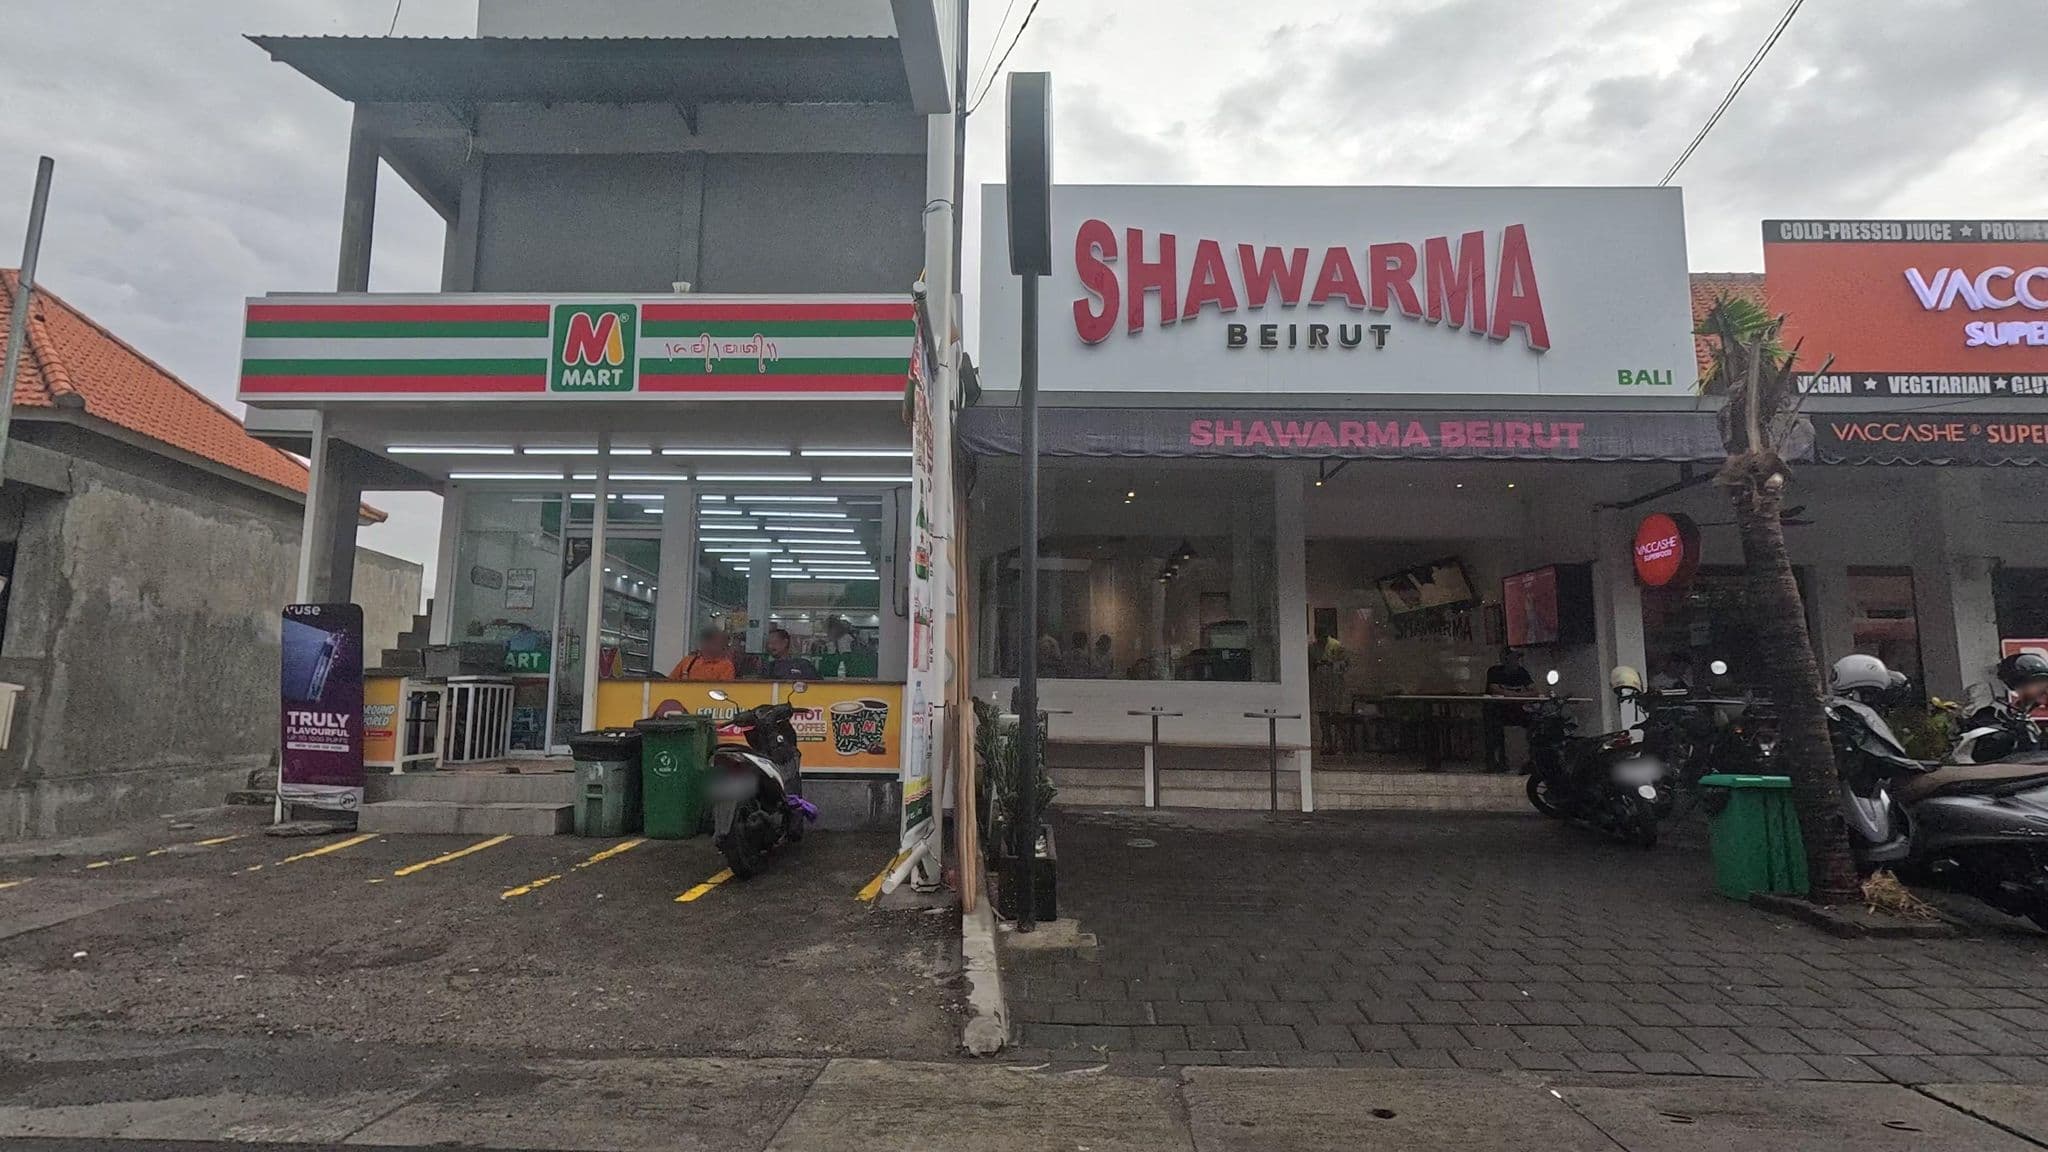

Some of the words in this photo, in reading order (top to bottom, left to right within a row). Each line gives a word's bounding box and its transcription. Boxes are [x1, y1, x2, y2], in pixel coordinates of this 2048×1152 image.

[1780, 222, 1900, 241] COLD-PRESSED
[1906, 222, 1952, 241] JUICE
[1073, 219, 1551, 352] SHAWARMA
[1227, 323, 1392, 349] BEIRUT
[561, 368, 624, 386] MART
[1617, 369, 1672, 385] BALI
[1797, 375, 1852, 394] VEGAN
[1888, 375, 1991, 394] VEGETARIAN
[1188, 419, 1430, 450] SHAWARMA
[1440, 421, 1585, 450] BEIRUT
[1831, 422, 1967, 442] VACCASHE
[1635, 536, 1678, 556] VACCASHE
[287, 711, 350, 728] TRULY
[794, 709, 823, 721] HOT
[287, 726, 350, 737] FLAVOURFUL
[792, 722, 826, 732] OFFEE
